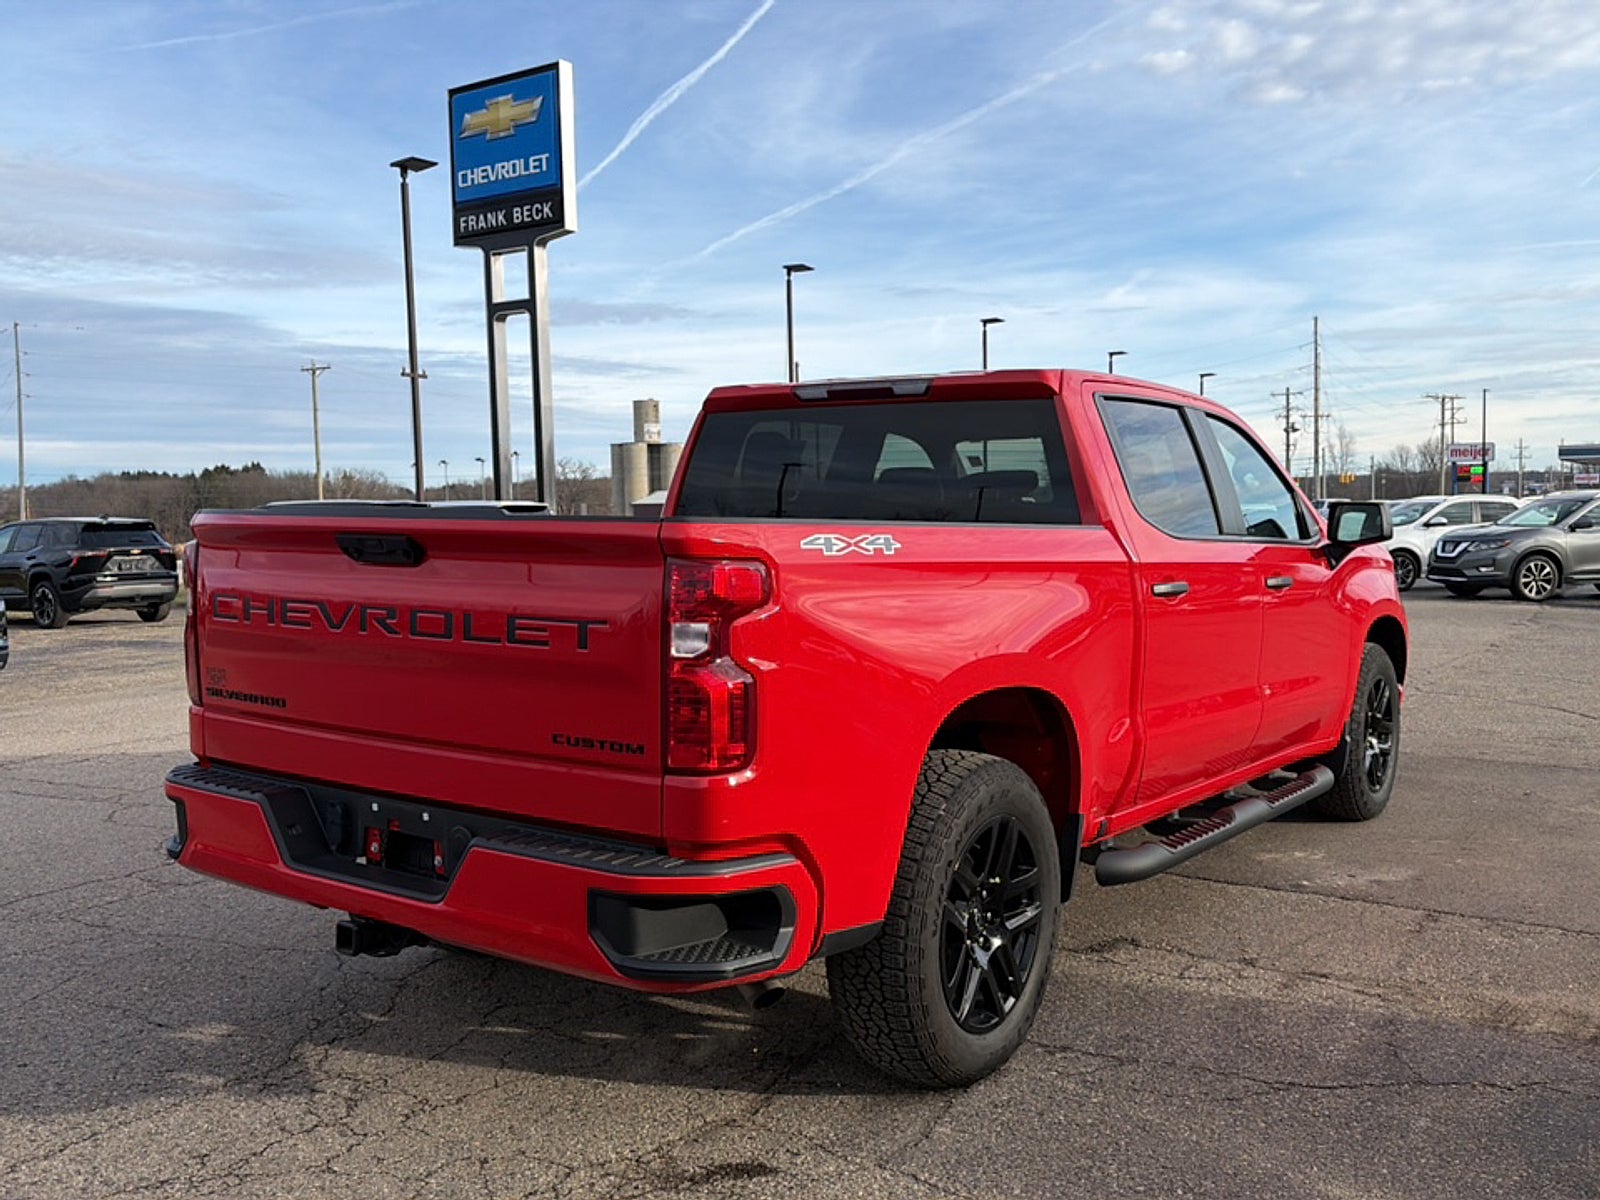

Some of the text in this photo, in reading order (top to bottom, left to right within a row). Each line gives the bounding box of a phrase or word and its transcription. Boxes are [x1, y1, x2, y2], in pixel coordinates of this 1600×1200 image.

[458, 153, 549, 187] CHEVROLET
[460, 201, 553, 233] FRANK BECK
[212, 593, 609, 652] CHEVROLET
[206, 686, 287, 708] SILVERADO
[552, 733, 645, 756] CUSTOM
